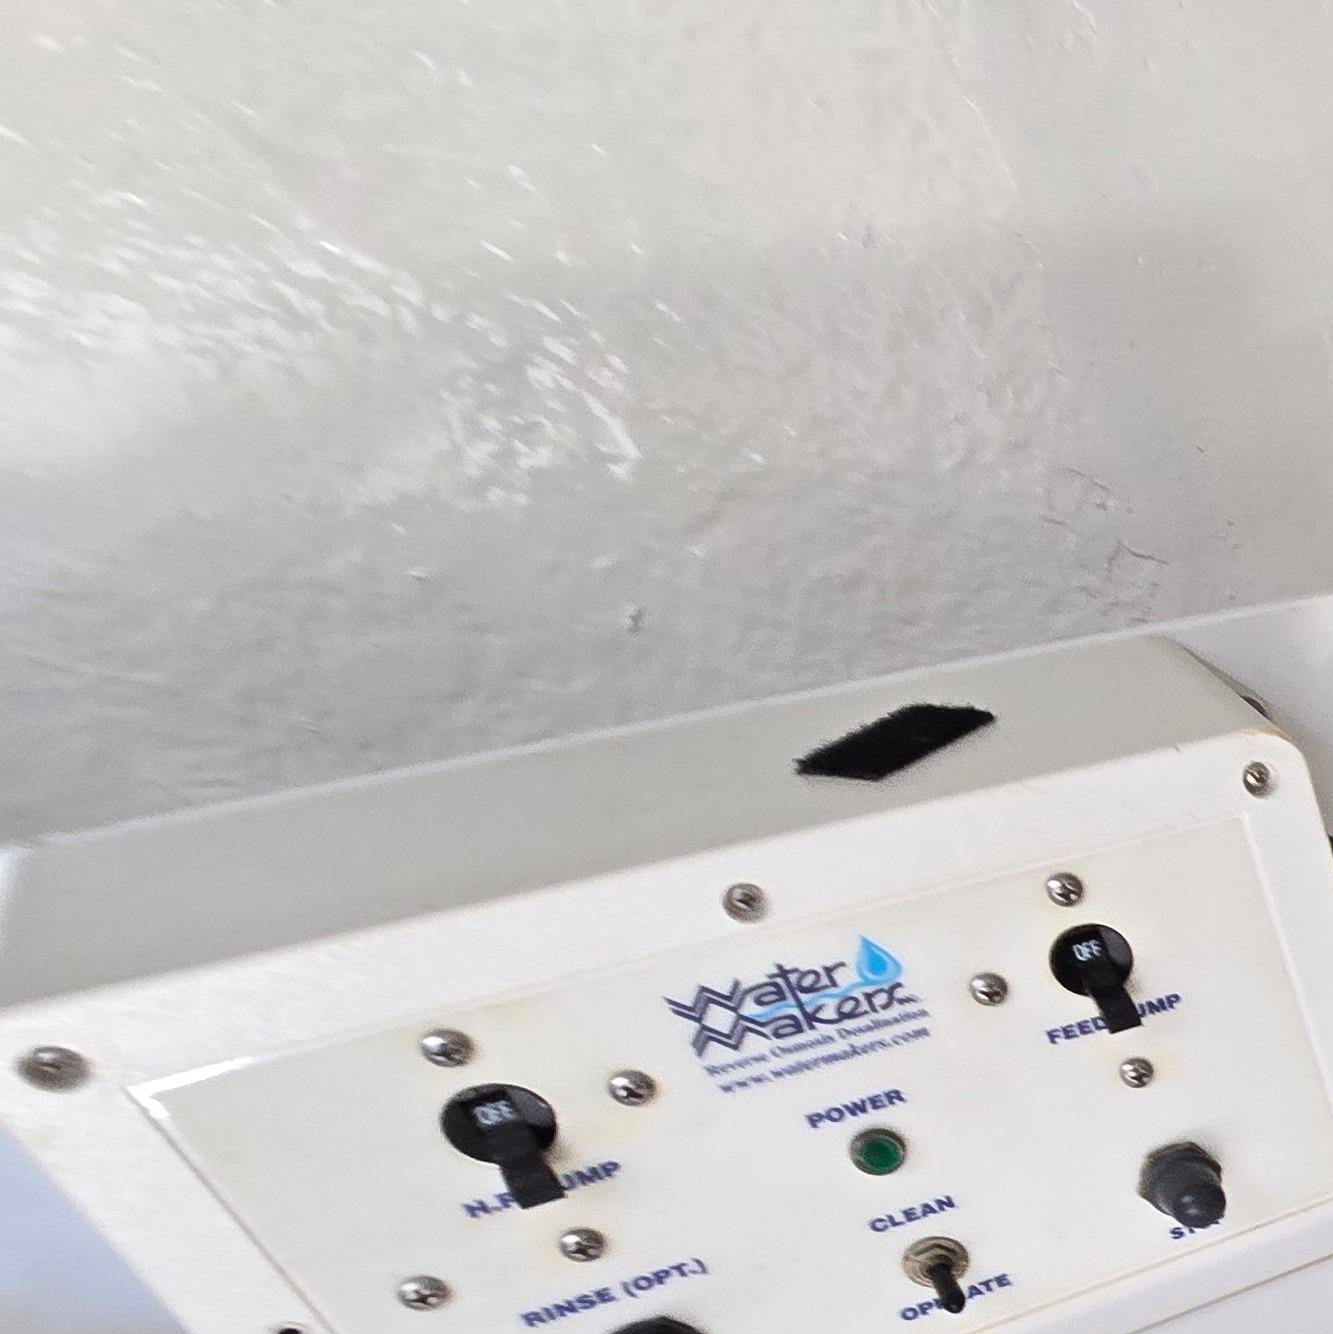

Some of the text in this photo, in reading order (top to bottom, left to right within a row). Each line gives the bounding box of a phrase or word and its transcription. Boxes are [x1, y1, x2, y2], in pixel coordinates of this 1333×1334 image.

[1071, 938, 1102, 962] OFF
[661, 961, 848, 1024] Water
[1046, 993, 1182, 1045] FEED UMP
[805, 1088, 906, 1129] POWER
[560, 1161, 622, 1191] UMP
[869, 1195, 957, 1233] CLEAN
[520, 1286, 618, 1328] RINSE
[899, 1273, 1013, 1321] OPEATE
